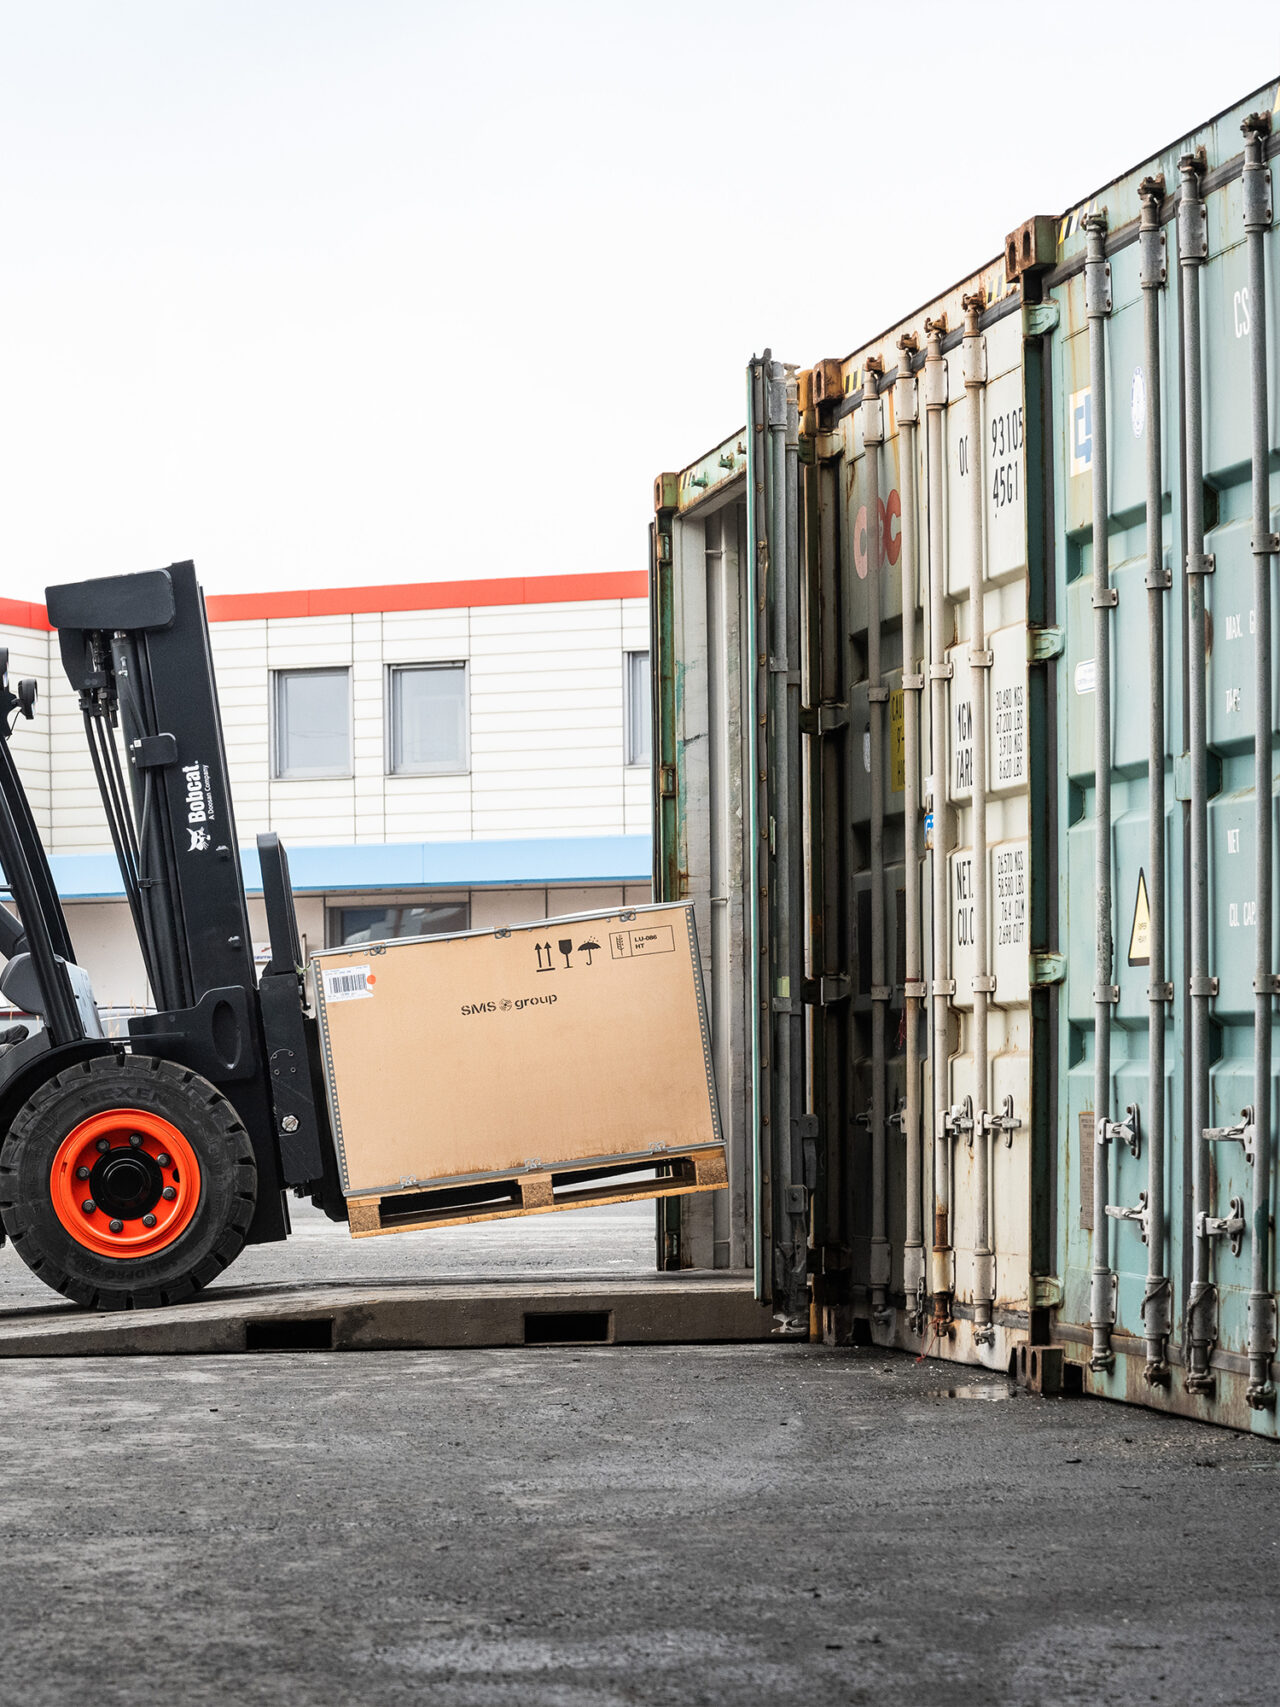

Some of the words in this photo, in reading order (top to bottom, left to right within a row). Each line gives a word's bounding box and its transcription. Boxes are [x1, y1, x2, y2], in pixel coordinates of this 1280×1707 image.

[993, 461, 1018, 508] 45G1
[203, 764, 211, 792] Company
[207, 792, 215, 815] Doosan
[1227, 828, 1240, 854] NET
[461, 1001, 497, 1016] SMS
[514, 994, 558, 1010] group
